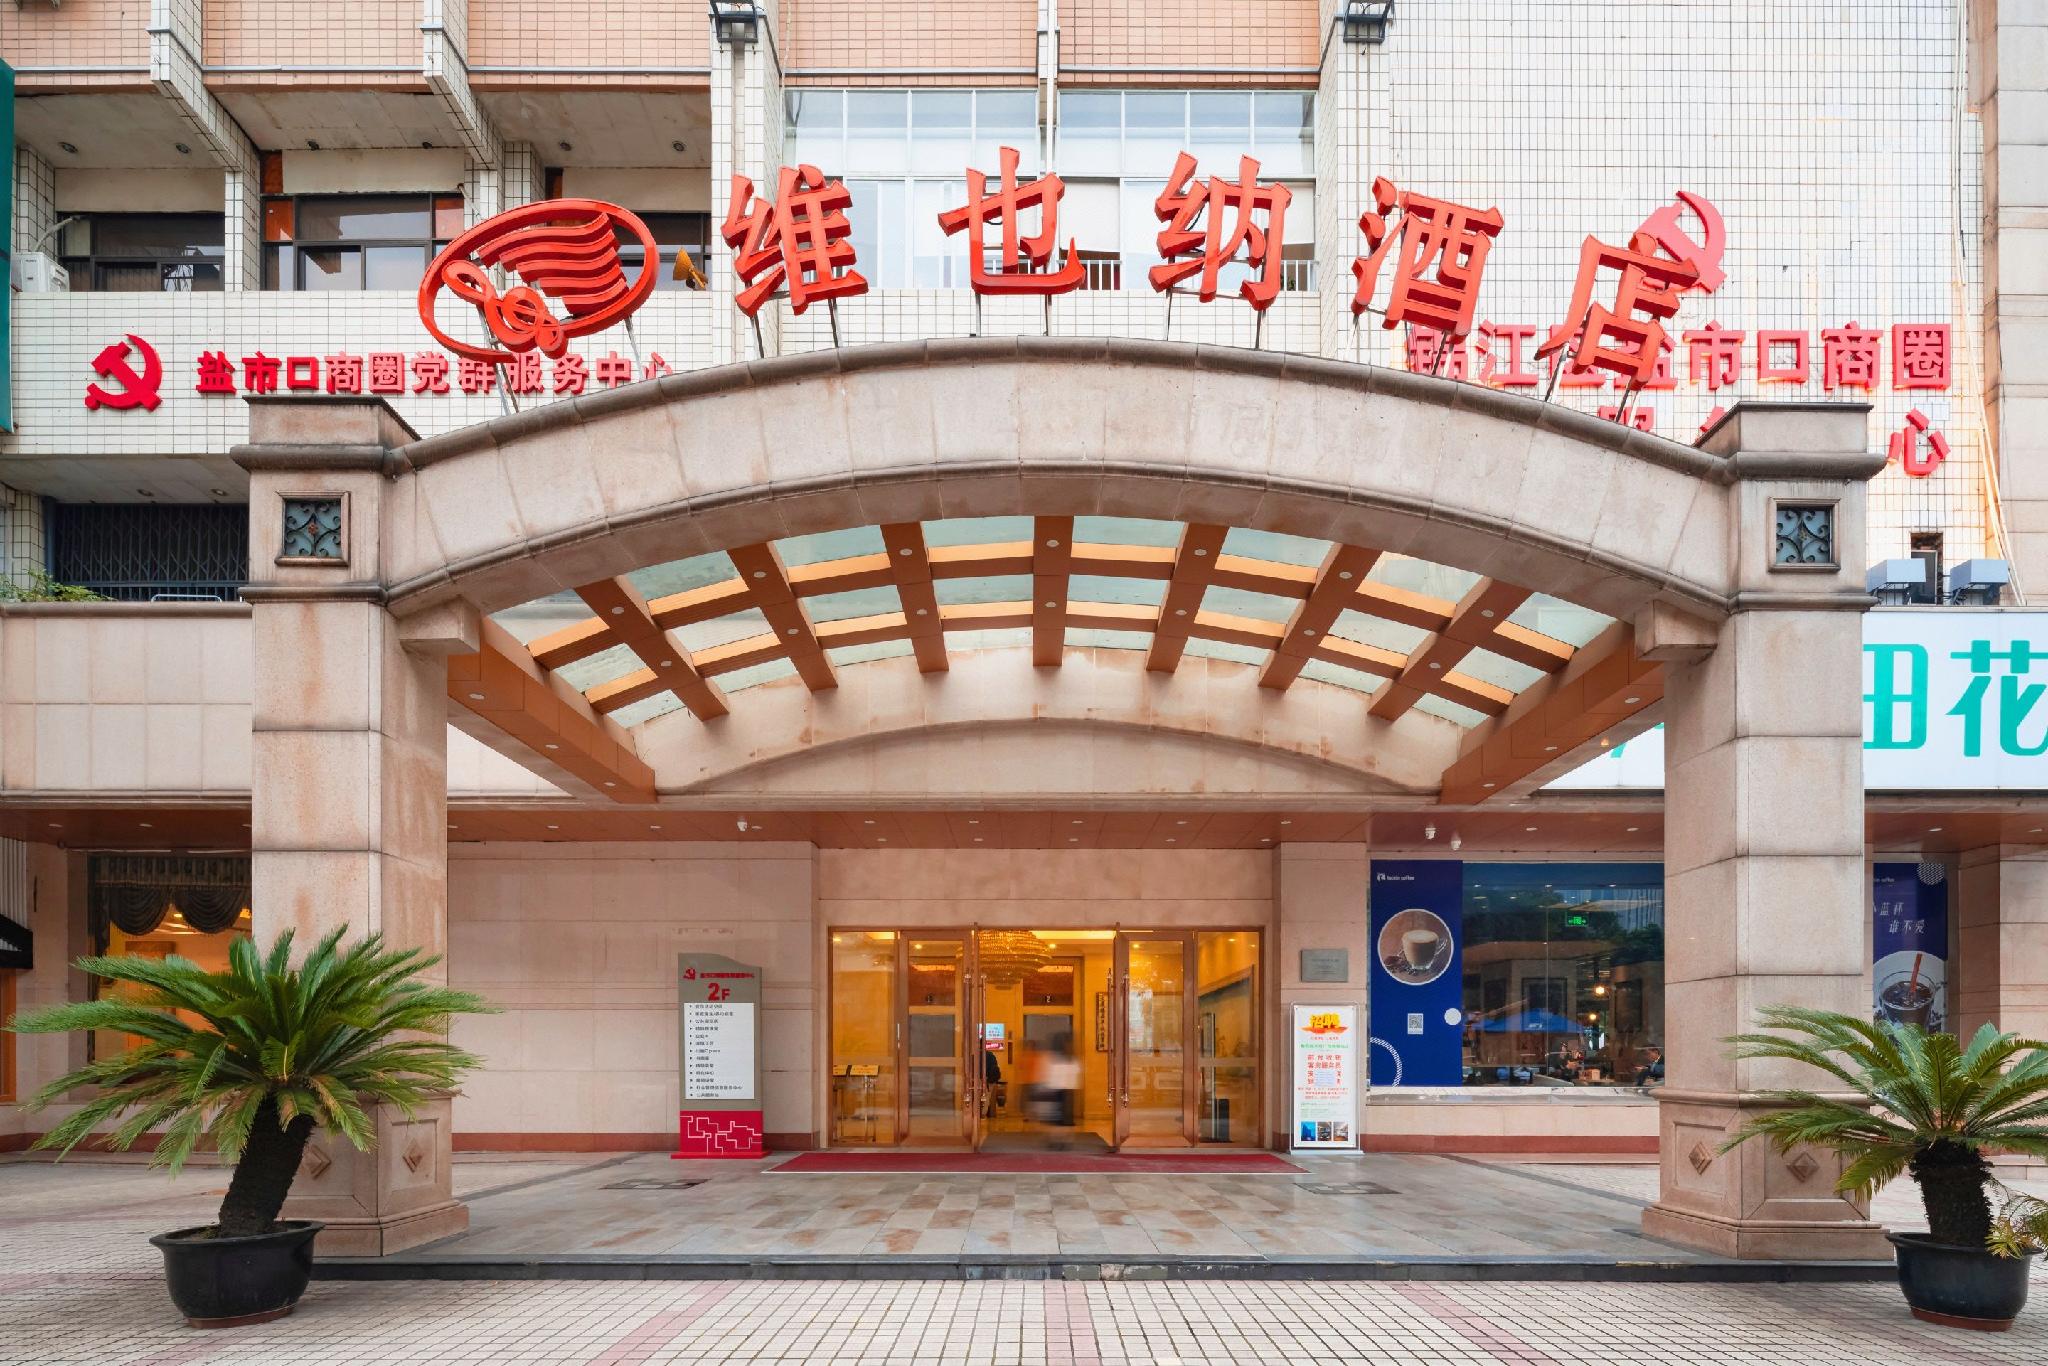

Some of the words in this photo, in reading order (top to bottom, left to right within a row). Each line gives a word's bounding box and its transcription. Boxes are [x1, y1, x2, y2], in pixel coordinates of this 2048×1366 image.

[720, 146, 1699, 389] 维也纳酒店
[708, 982, 731, 1001] 2F
